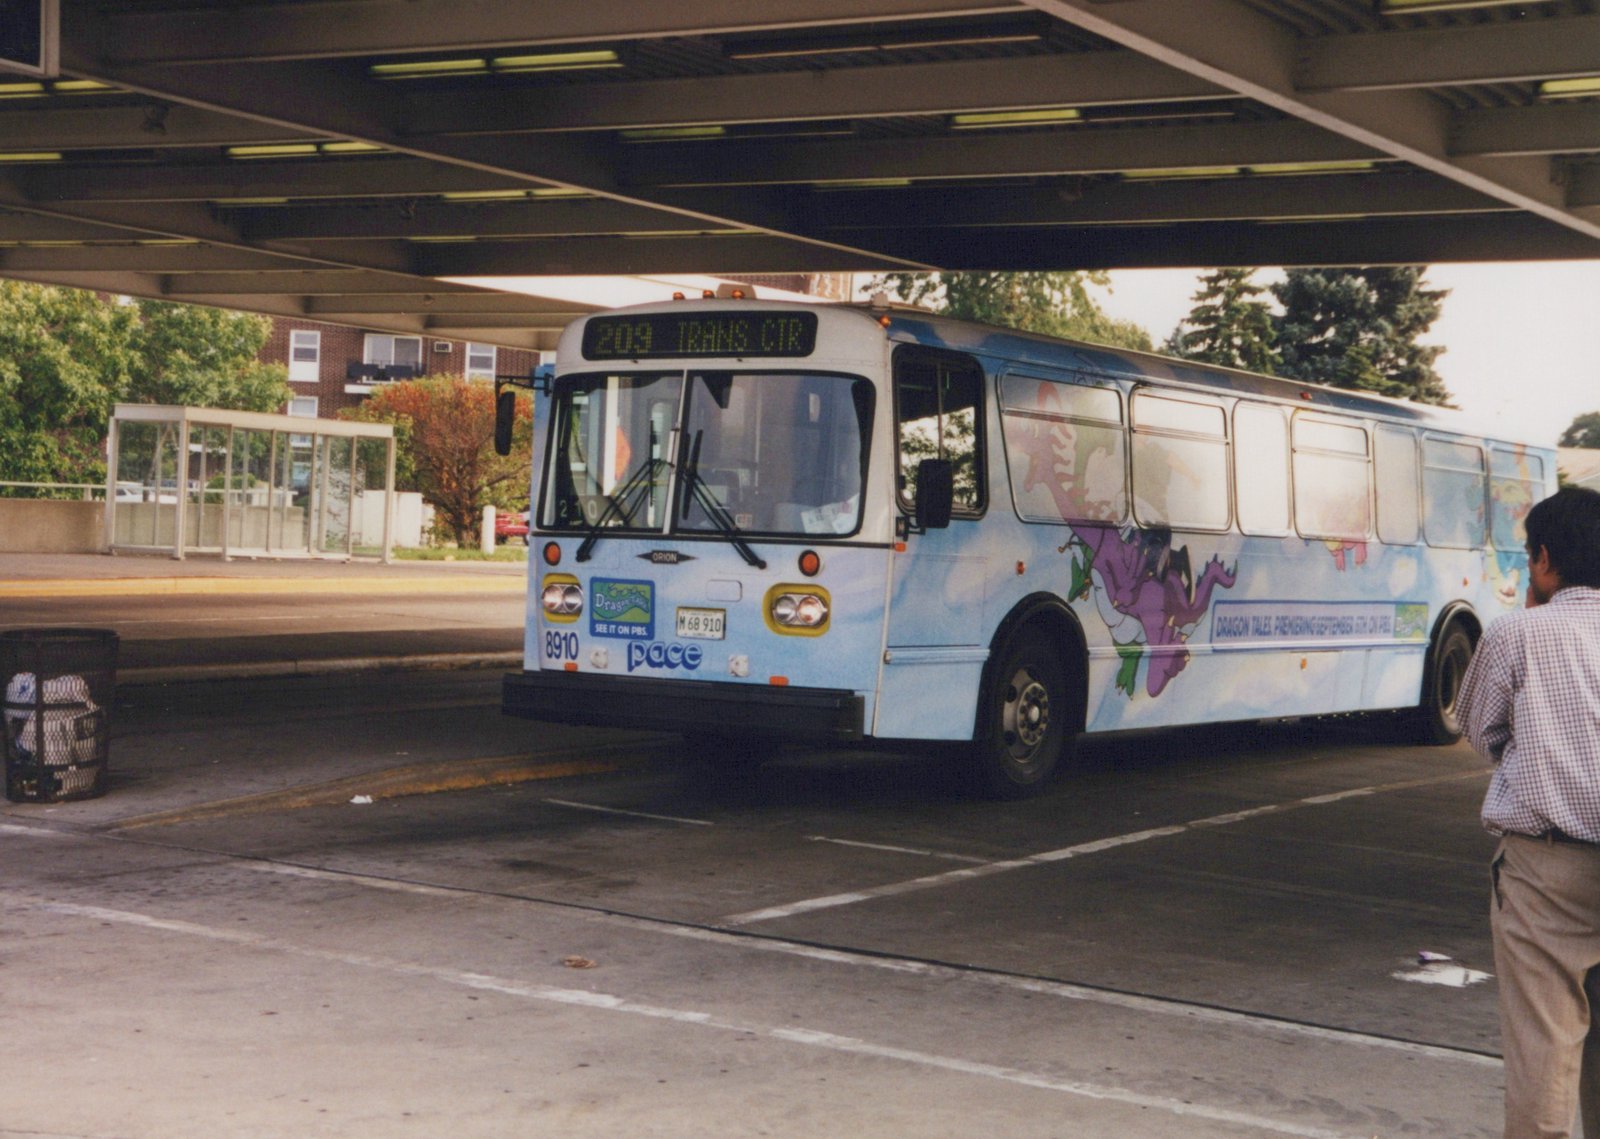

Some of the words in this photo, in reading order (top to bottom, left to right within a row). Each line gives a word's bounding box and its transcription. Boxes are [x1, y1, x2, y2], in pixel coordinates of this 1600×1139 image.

[596, 322, 652, 354] 209
[678, 319, 749, 353] TRANS
[761, 318, 803, 351] CTR
[652, 552, 678, 562] ORION
[595, 624, 608, 634] SEE
[609, 625, 616, 634] IT
[618, 625, 630, 635] ON
[688, 616, 700, 631] 68
[703, 617, 721, 632] 910
[1216, 615, 1249, 638] DRAGON
[546, 630, 579, 661] 8910
[627, 640, 703, 672] pace
